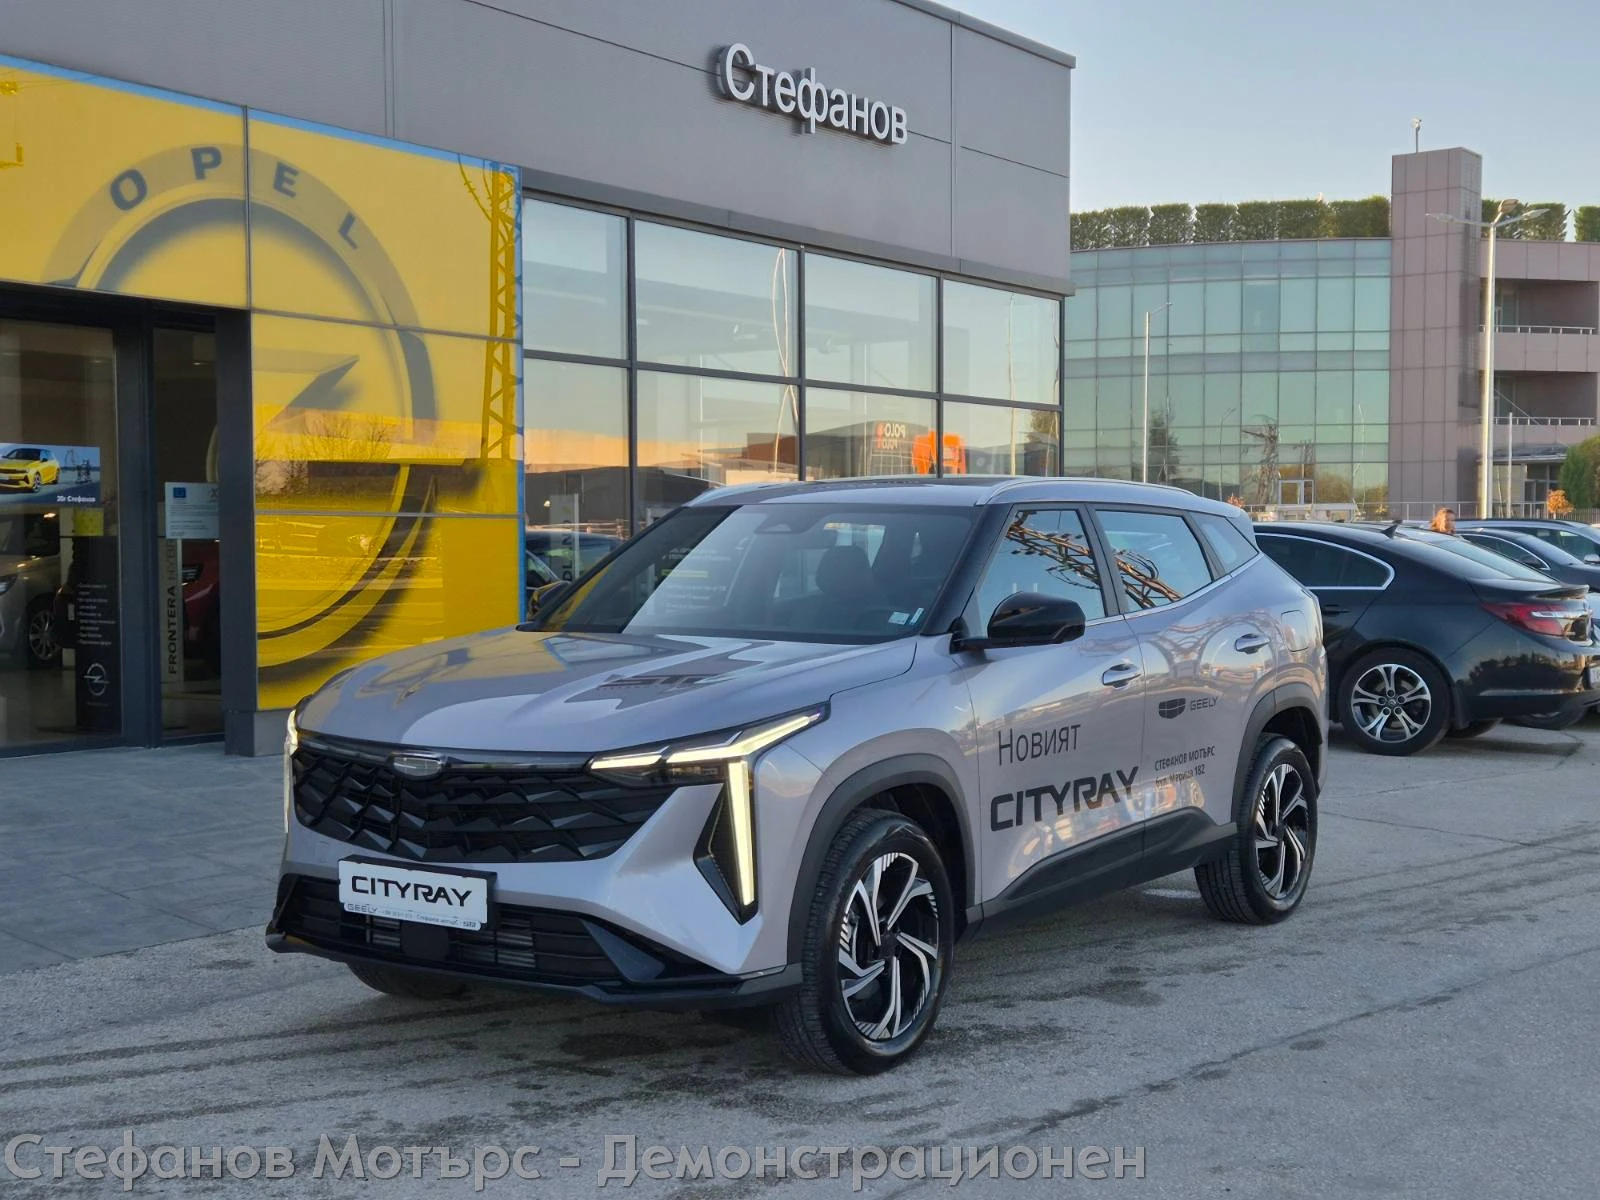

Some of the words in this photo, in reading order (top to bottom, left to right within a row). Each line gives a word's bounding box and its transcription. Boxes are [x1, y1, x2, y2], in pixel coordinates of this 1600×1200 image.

[720, 42, 908, 145] Стефанов
[109, 146, 359, 249] OPEL
[167, 585, 177, 675] FRONTERA
[1190, 696, 1219, 711] GEELY
[998, 724, 1081, 767] Новият
[1154, 752, 1187, 772] СТЕФАНОВ
[990, 766, 1139, 832] CITYRAY
[351, 875, 473, 907] CITYRAY
